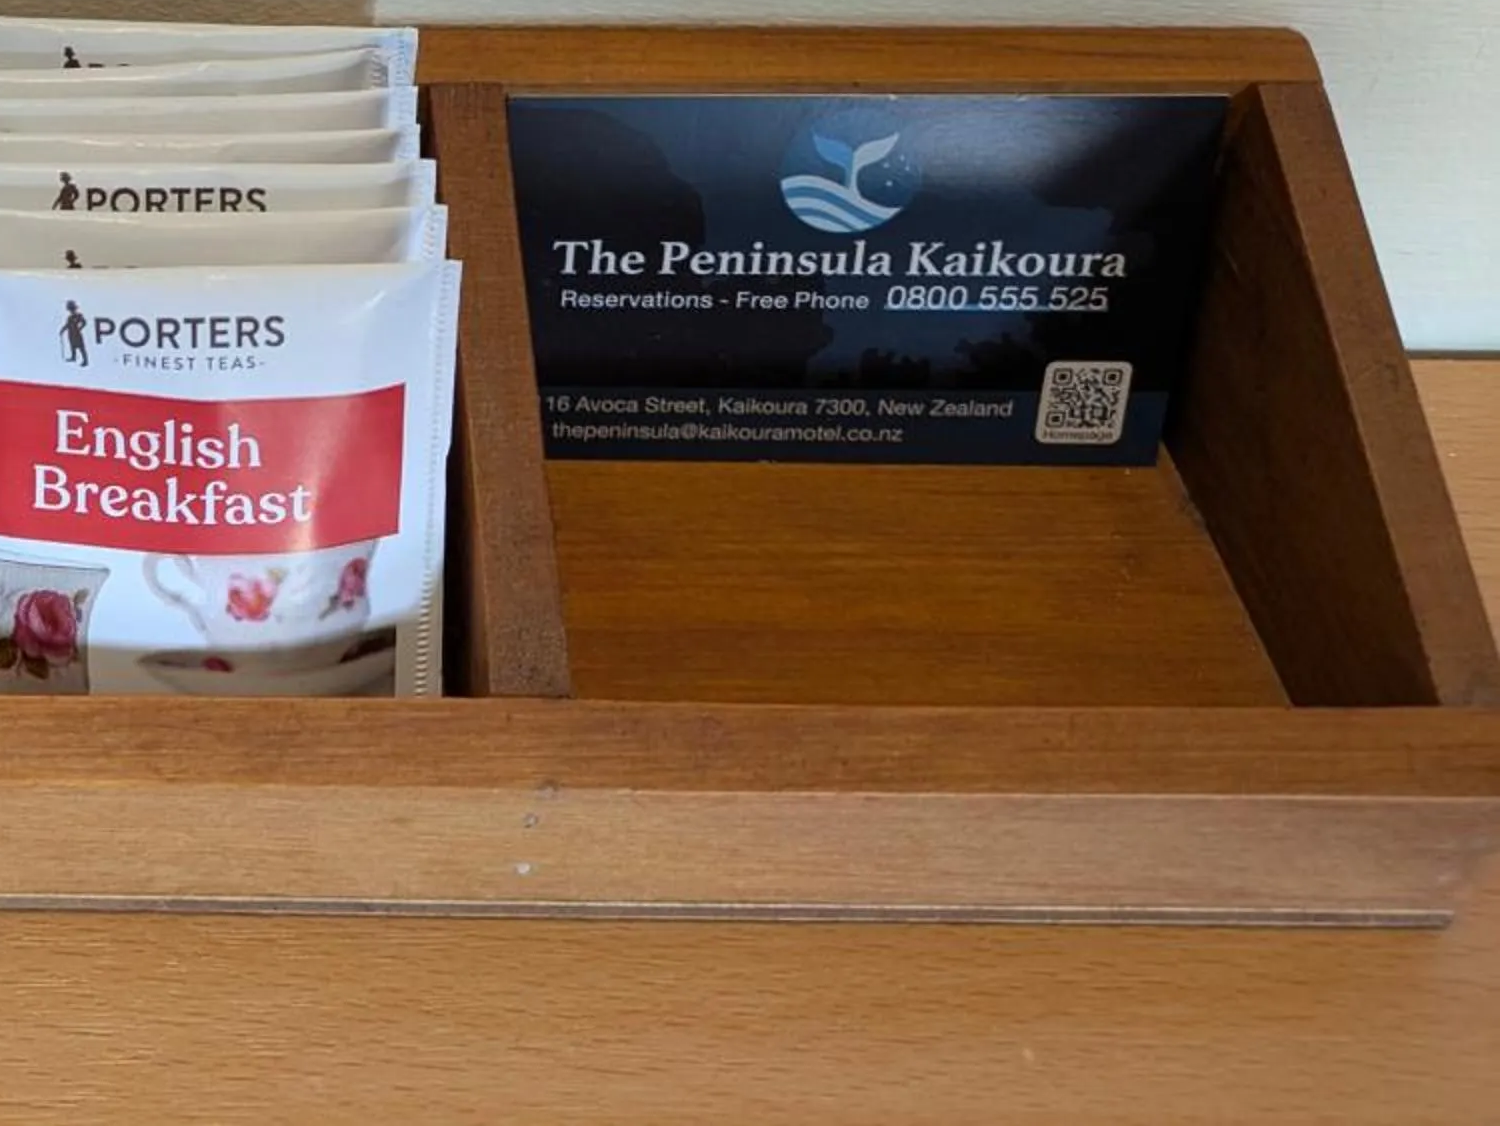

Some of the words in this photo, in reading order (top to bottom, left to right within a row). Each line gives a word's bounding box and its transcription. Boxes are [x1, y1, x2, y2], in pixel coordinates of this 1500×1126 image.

[86, 186, 267, 212] PORTERS
[553, 239, 646, 275] The
[657, 239, 892, 276] Peninsula
[905, 240, 1127, 277] Kaikoura
[560, 289, 713, 309] Reservations
[735, 290, 788, 309] Free
[793, 290, 870, 310] Phone
[886, 285, 969, 311] 0800
[978, 285, 1040, 311] 555
[1048, 285, 1109, 311] 525
[94, 315, 285, 348] PORTERS
[547, 395, 570, 413] 16
[575, 395, 638, 414] Avoca
[644, 396, 711, 416] Street,
[718, 397, 808, 415] Kaikoura
[814, 398, 871, 417] 7300,
[877, 399, 924, 417] New
[928, 399, 1014, 417] Zealand
[55, 408, 262, 472] English
[552, 422, 904, 442] thepeninsula@kaikouramotel.co.nz
[32, 463, 314, 526] Breakfast
